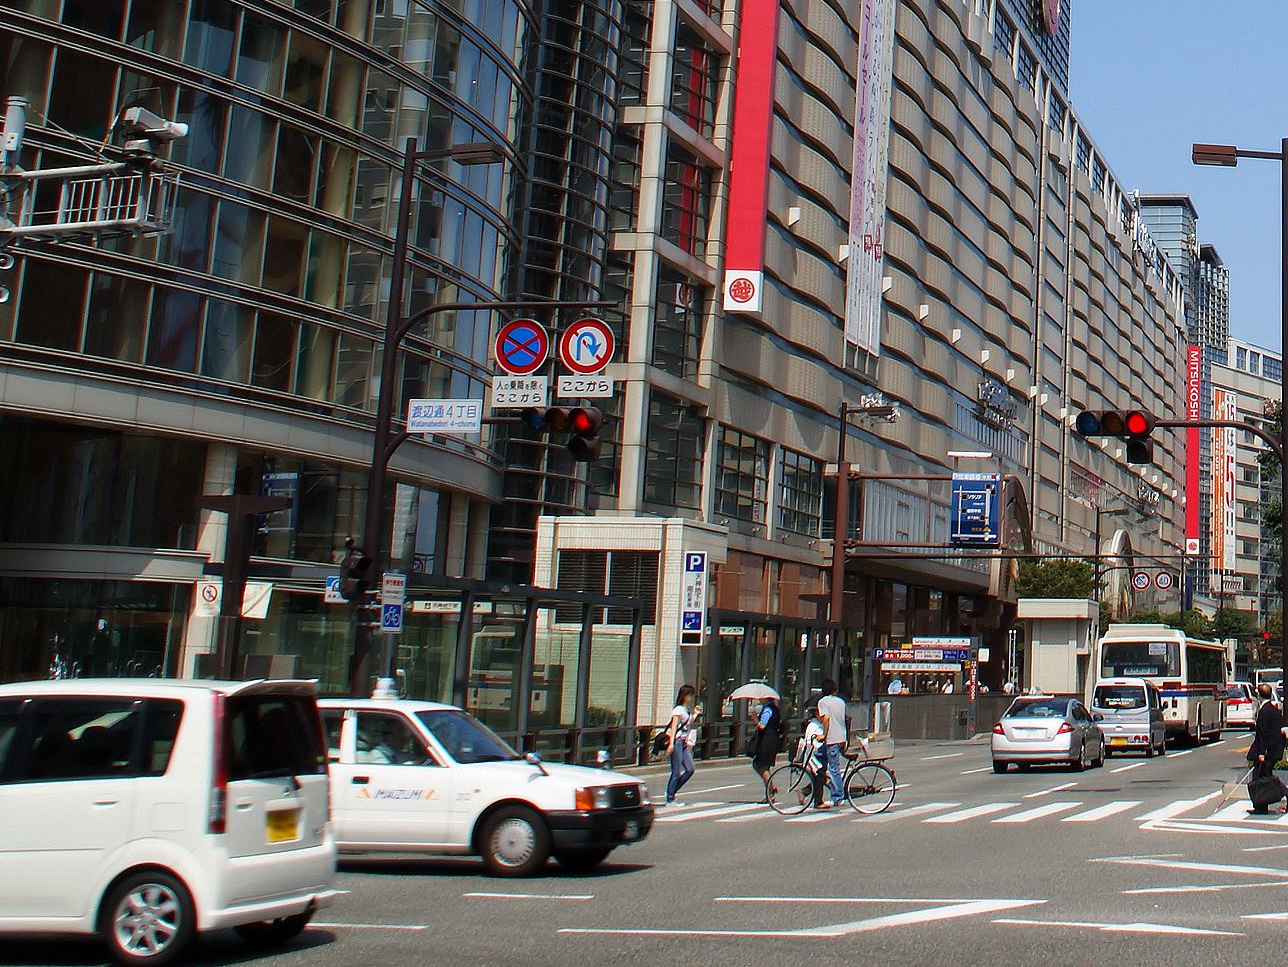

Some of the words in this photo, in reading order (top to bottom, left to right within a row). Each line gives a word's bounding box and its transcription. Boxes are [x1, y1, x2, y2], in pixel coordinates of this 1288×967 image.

[562, 380, 609, 392] ここから
[1190, 350, 1199, 421] MITSUKOSHI
[496, 393, 542, 403] ここから
[411, 405, 477, 418] 渡辺通4丁目
[689, 554, 702, 571] P
